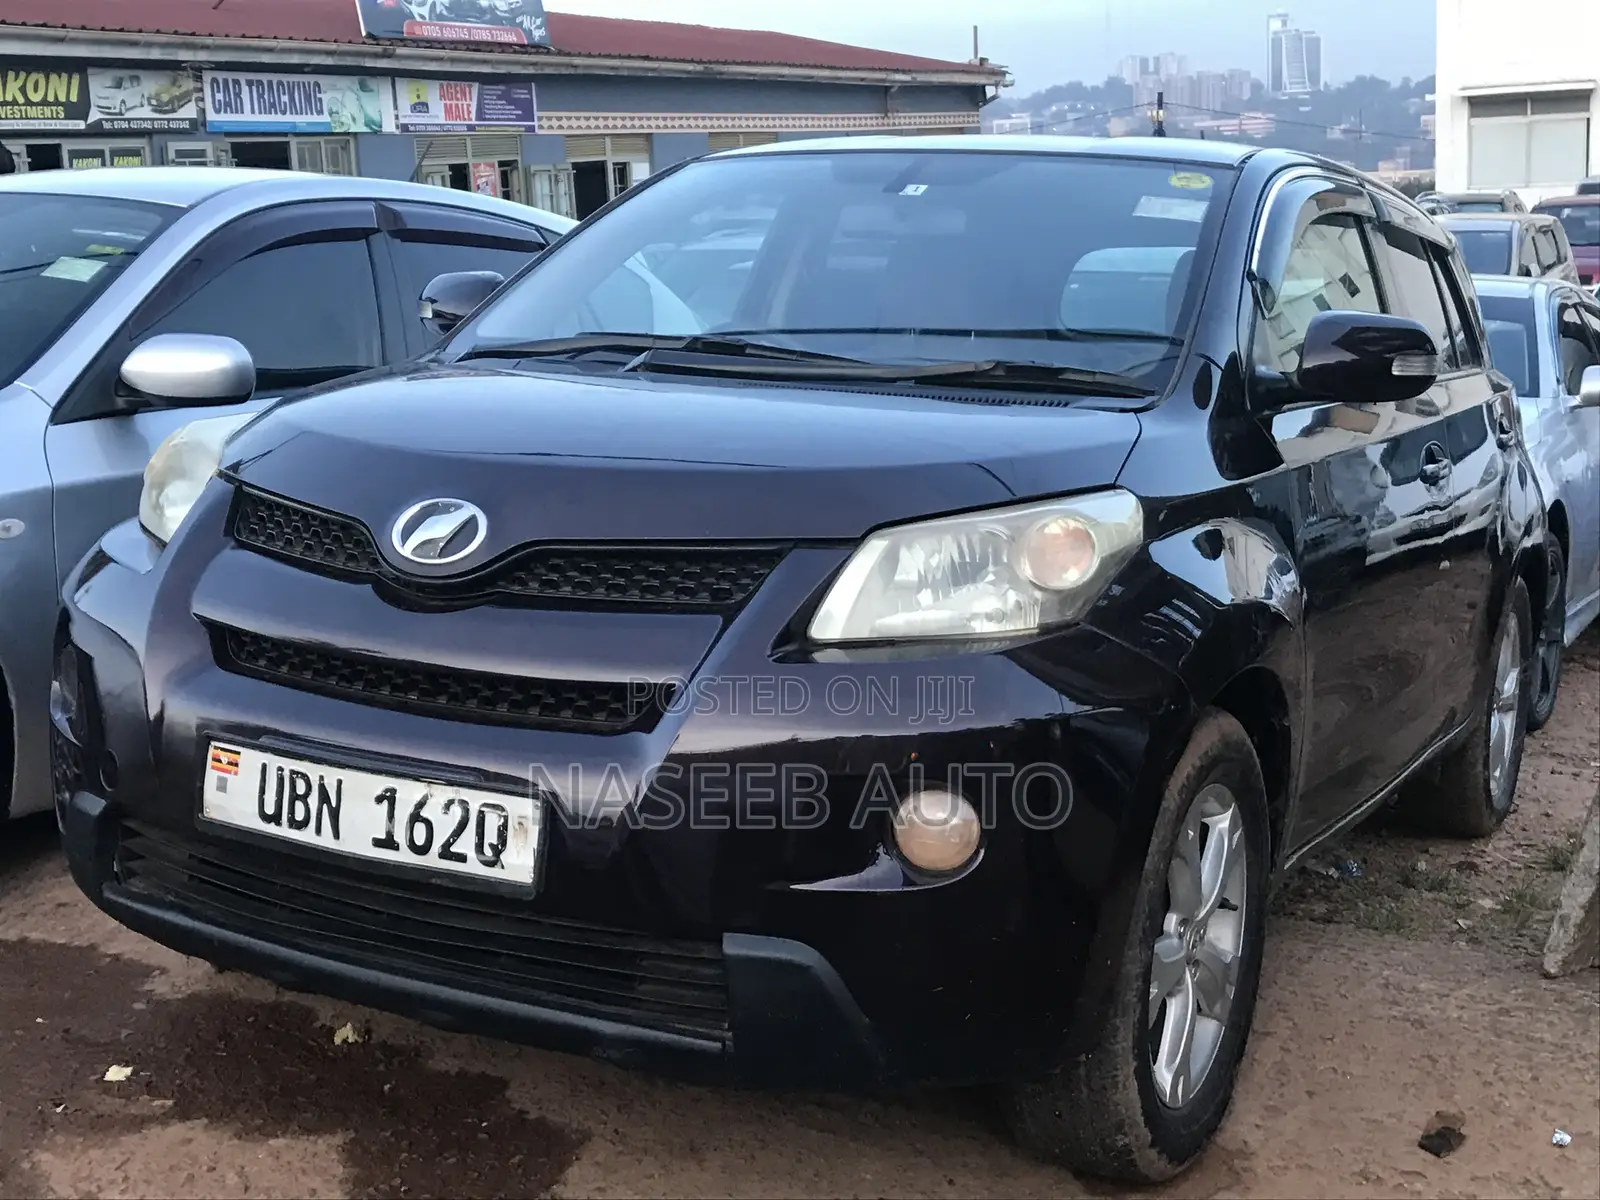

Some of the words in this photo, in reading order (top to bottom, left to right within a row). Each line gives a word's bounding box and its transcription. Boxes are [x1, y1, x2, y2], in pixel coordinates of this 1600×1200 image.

[422, 25, 441, 37] 0705
[210, 77, 244, 115] CAR
[245, 79, 324, 116] TRACKING
[439, 83, 473, 101] AGENT
[444, 103, 473, 121] MALE
[102, 120, 113, 129] Tel:
[154, 120, 169, 129] 0772
[73, 158, 101, 168] KAKONI
[113, 156, 142, 166] KAKONI
[257, 761, 343, 841] UBN
[371, 786, 509, 870] 162Q
